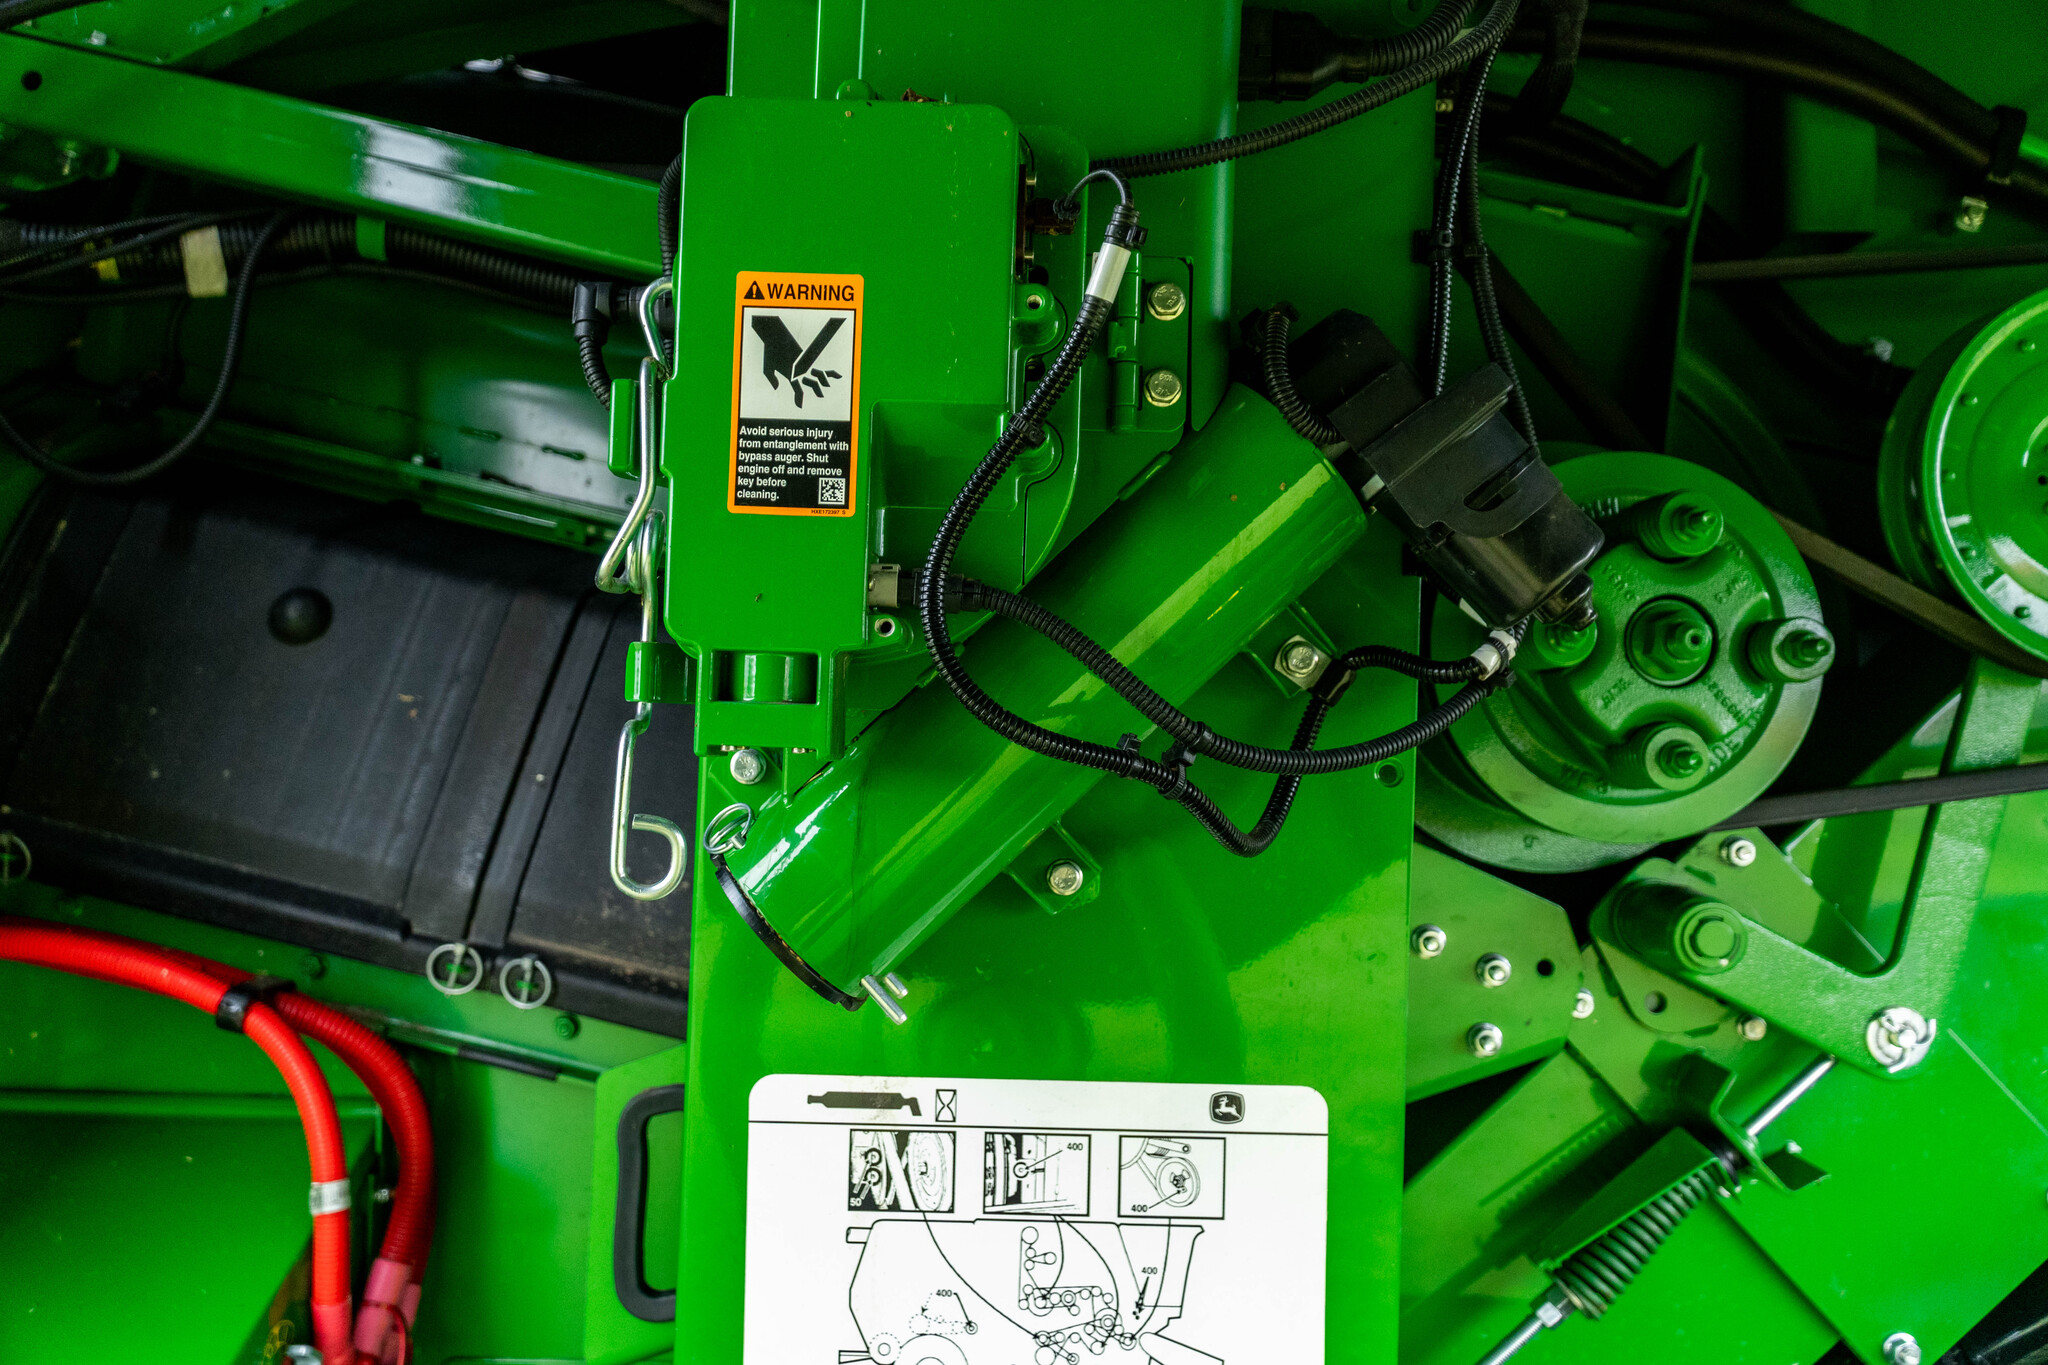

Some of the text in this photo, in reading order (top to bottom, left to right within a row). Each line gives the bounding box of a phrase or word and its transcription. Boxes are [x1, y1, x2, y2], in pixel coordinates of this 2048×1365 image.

[768, 282, 854, 302] WARNING
[739, 426, 833, 440] Avoid serious injury
[739, 438, 849, 451] from entanglement with
[739, 451, 829, 463] bypass auger. Shut
[738, 464, 769, 474] engine
[772, 465, 785, 474] off
[787, 466, 804, 474] and
[738, 476, 786, 487] key before
[737, 489, 779, 500] cleaning.
[1067, 1142, 1083, 1151] 400
[850, 1198, 862, 1206] 50
[1131, 1204, 1148, 1213] 400
[1142, 1266, 1158, 1275] 400
[936, 1289, 952, 1298] 400
